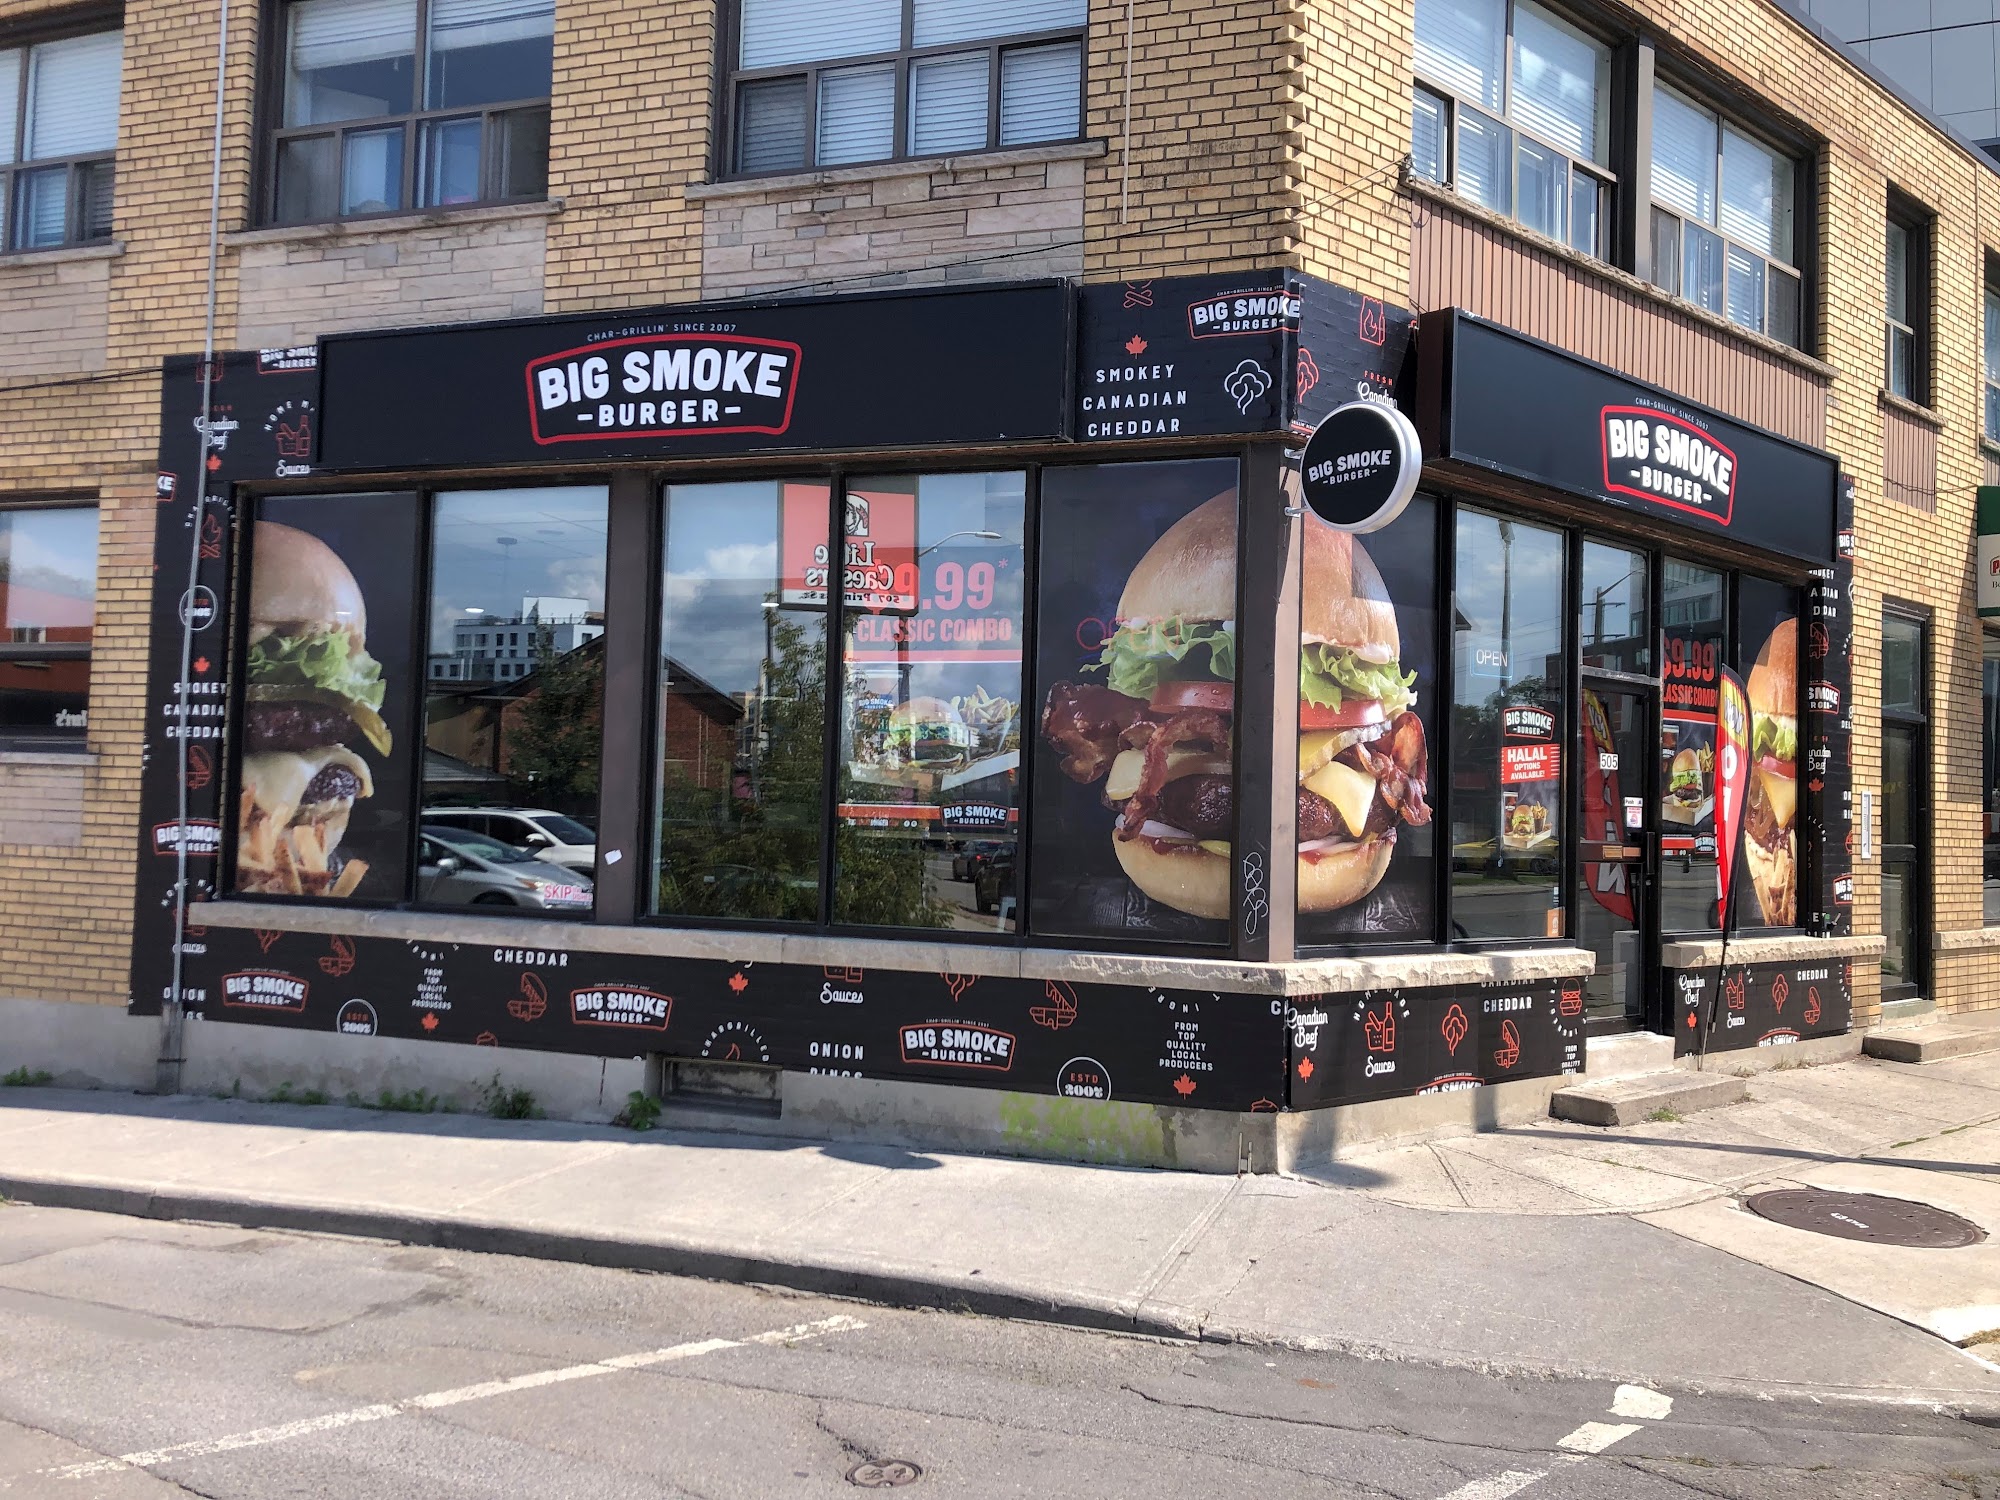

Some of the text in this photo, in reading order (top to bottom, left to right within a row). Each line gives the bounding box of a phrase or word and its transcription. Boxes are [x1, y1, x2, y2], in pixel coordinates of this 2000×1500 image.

[1193, 295, 1300, 326] BIG SMOKE
[674, 323, 705, 332] SINCE
[709, 323, 737, 333] 2007
[537, 348, 788, 410] BIG SMOKE
[1095, 363, 1175, 383] SMOKEY
[1364, 370, 1394, 387] FRESH
[1083, 390, 1187, 411] CANADIAN
[1679, 410, 1695, 422] SINCE
[1087, 418, 1181, 438] CHEDDAR
[1609, 418, 1733, 496] BIG SMOKE
[1308, 450, 1393, 483] BIG SMOKE
[857, 617, 1013, 643] CLASSIC COMBO
[1475, 649, 1508, 667] OPEN
[1505, 711, 1552, 731] BIG SMOKE
[1507, 747, 1548, 763] HALAL
[1601, 754, 1618, 769] 505
[1513, 762, 1541, 771] OPTIONS
[943, 805, 1007, 820] BIG SMOKE
[544, 885, 572, 899] SKIP
[494, 949, 568, 966] CHEDDAR
[1797, 968, 1829, 982] CHEDDAR
[226, 976, 305, 1000] BIG SMOKE
[820, 982, 864, 1004] Sauces
[575, 991, 668, 1018] BIG SMOKE
[1483, 996, 1533, 1013] CHEDDAR
[1286, 1006, 1329, 1027] Canadian
[1174, 1021, 1199, 1032] FROM
[905, 1028, 1011, 1057] BIG SMOKE
[1177, 1031, 1196, 1041] TOP
[1294, 1026, 1319, 1052] Beef
[809, 1041, 864, 1060] ONION
[1165, 1040, 1207, 1051] QUALITY
[1171, 1050, 1201, 1060] LOCAL
[1158, 1058, 1214, 1072] PRODUCERS
[1364, 1055, 1396, 1078] Sauces
[1070, 1072, 1099, 1085] ESTD
